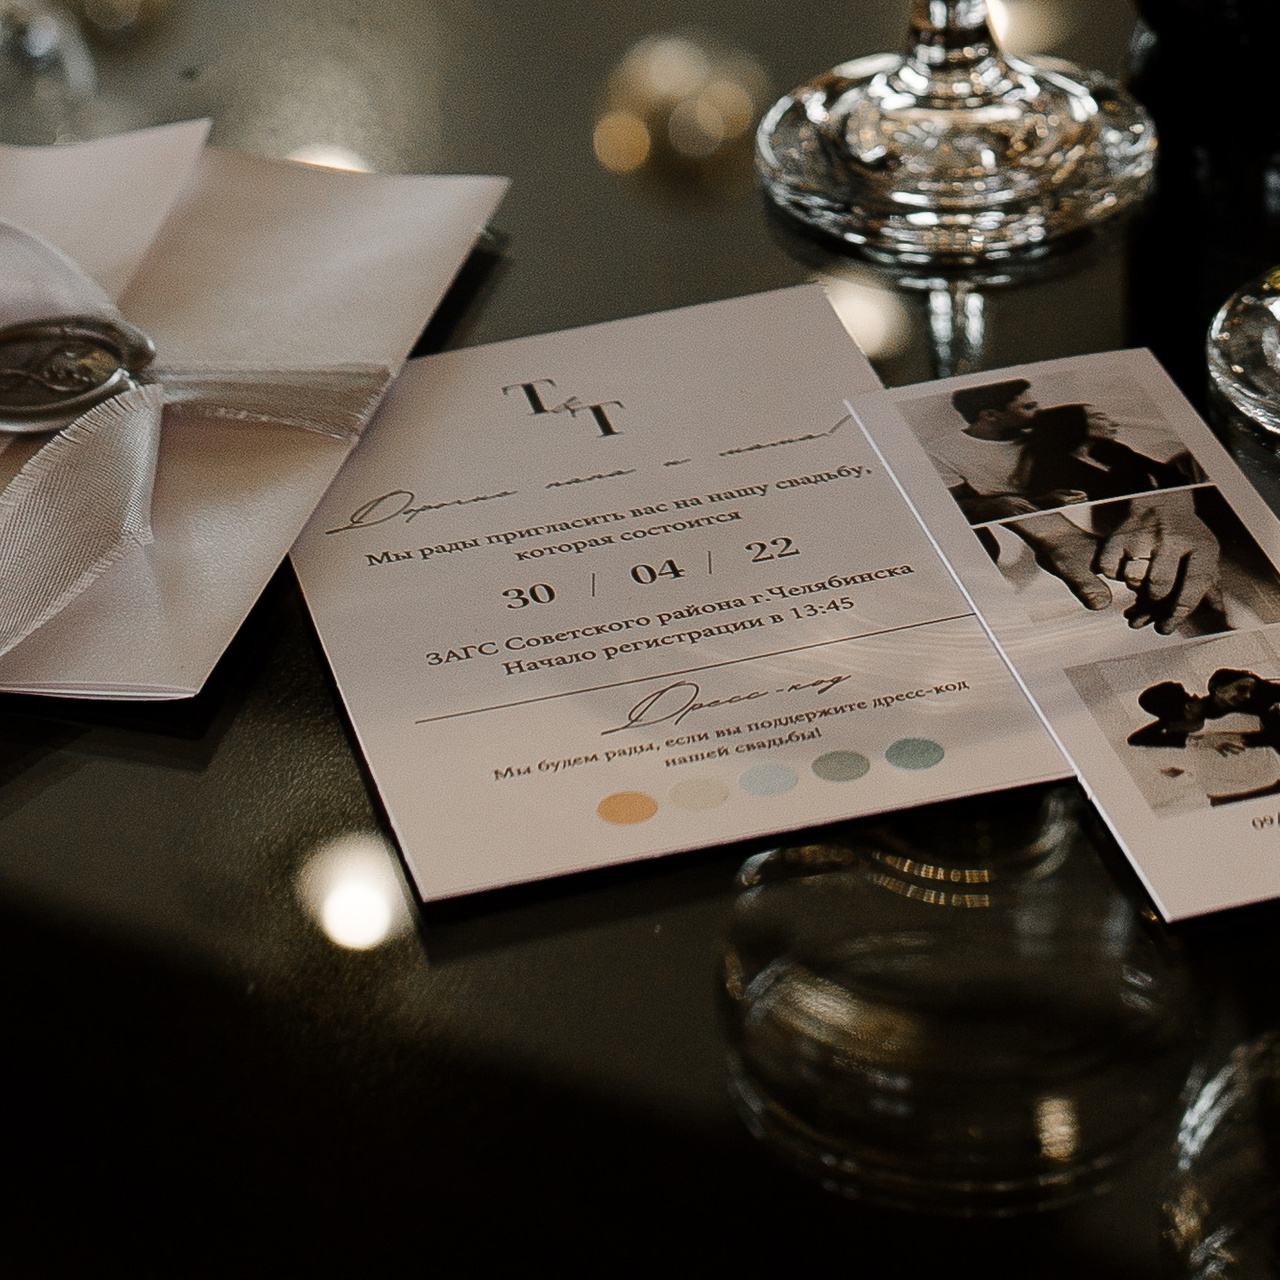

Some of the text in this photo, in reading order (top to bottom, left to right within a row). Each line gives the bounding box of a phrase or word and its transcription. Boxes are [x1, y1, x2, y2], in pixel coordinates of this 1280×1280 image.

[364, 463, 873, 567] Мы рады пригласить вас на нашу свадьбу,
[514, 509, 743, 561] которая состоится
[502, 583, 556, 610] 30
[630, 558, 686, 585] 04
[744, 536, 801, 564] 22
[425, 563, 915, 667] ЗАГС Советского района г.Челябинска
[502, 596, 855, 676] Начало регистрации в 13:45
[493, 679, 971, 782] Мы будем рады, если вы поддержите дресс-код
[664, 726, 823, 768] нашей свадьбы!
